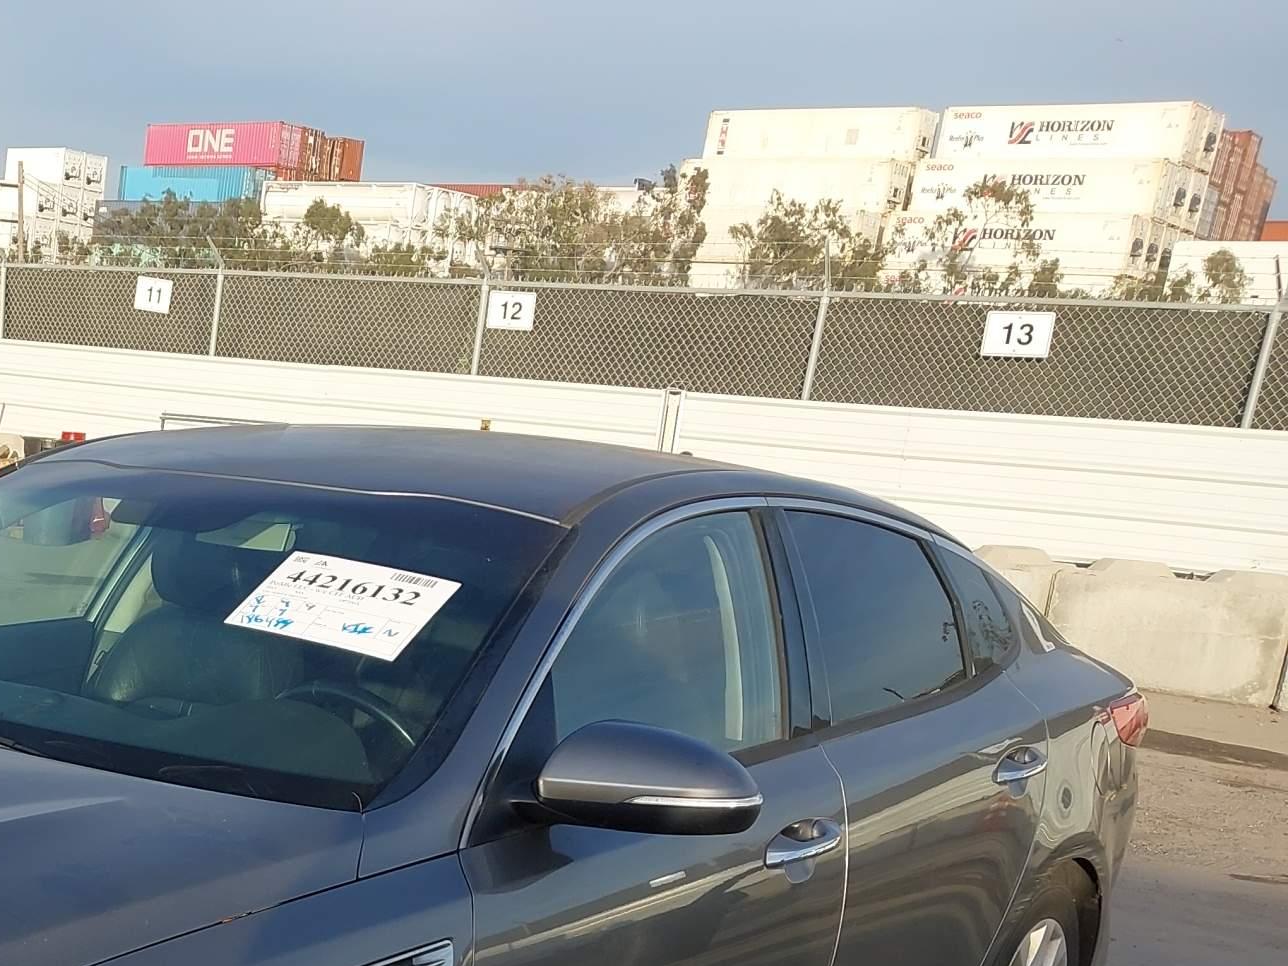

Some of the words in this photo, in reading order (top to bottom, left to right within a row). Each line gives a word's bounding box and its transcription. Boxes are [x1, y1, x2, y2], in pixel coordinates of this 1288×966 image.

[953, 111, 982, 120] seaco
[1038, 119, 1115, 133] HORIZON
[187, 128, 236, 153] ONE
[1036, 133, 1100, 142] LINES
[925, 163, 954, 171] seaco
[1010, 174, 1087, 186] HORIZON
[981, 228, 1056, 241] HORIZON
[147, 287, 162, 303] 11
[501, 301, 523, 320] 12
[1003, 322, 1034, 346] 13
[287, 569, 421, 606] 44216132
